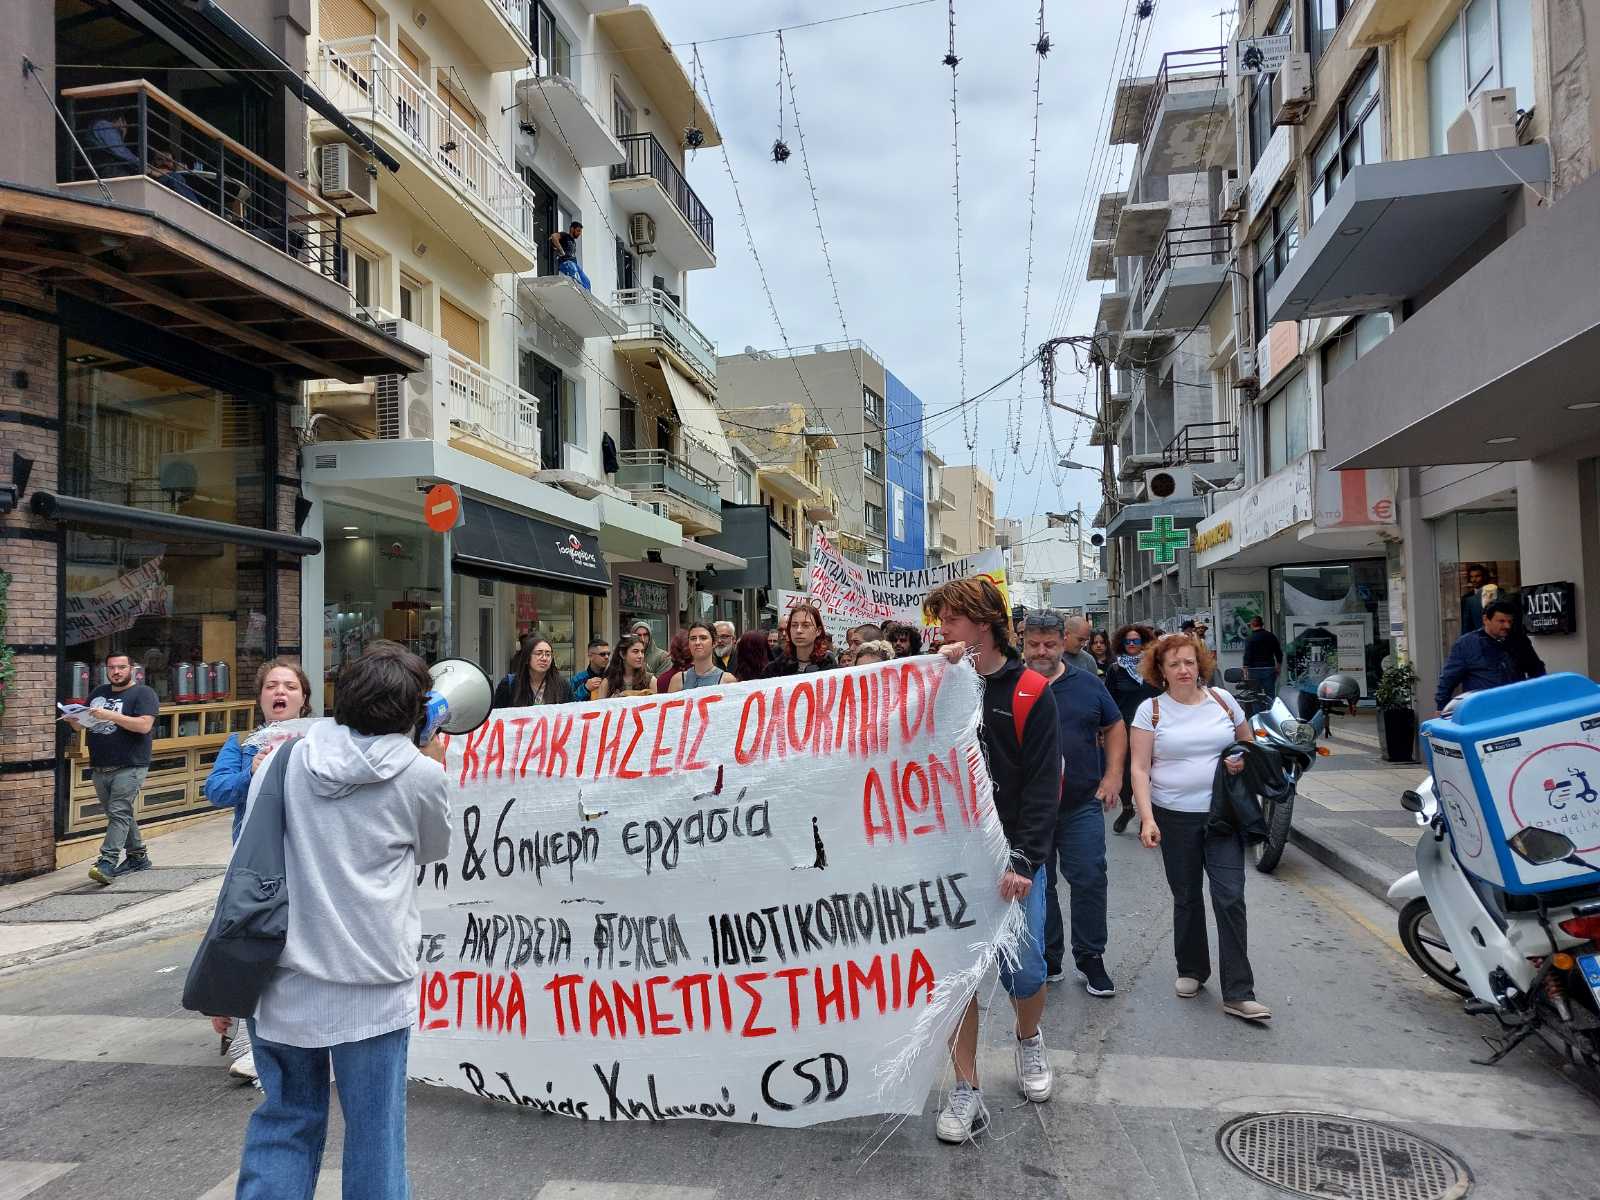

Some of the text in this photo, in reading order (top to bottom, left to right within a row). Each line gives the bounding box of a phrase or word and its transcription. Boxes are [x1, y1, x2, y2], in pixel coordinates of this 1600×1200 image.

[1527, 591, 1562, 615] MEN
[459, 660, 946, 787] ΚΑΤΑΚΤΗΣΕΙΣ ΟΛΟΚΛΗΡΟΥ
[461, 805, 488, 882] &
[621, 786, 773, 876] εργασία
[709, 872, 977, 968] ΙΔΙΩΤΙΚΟΠΟΙΗΣΕΙΣ
[543, 948, 936, 1038] ΠΑΝΕΠΙΣΤΗΜΙΑ
[761, 1052, 850, 1112] CSD
